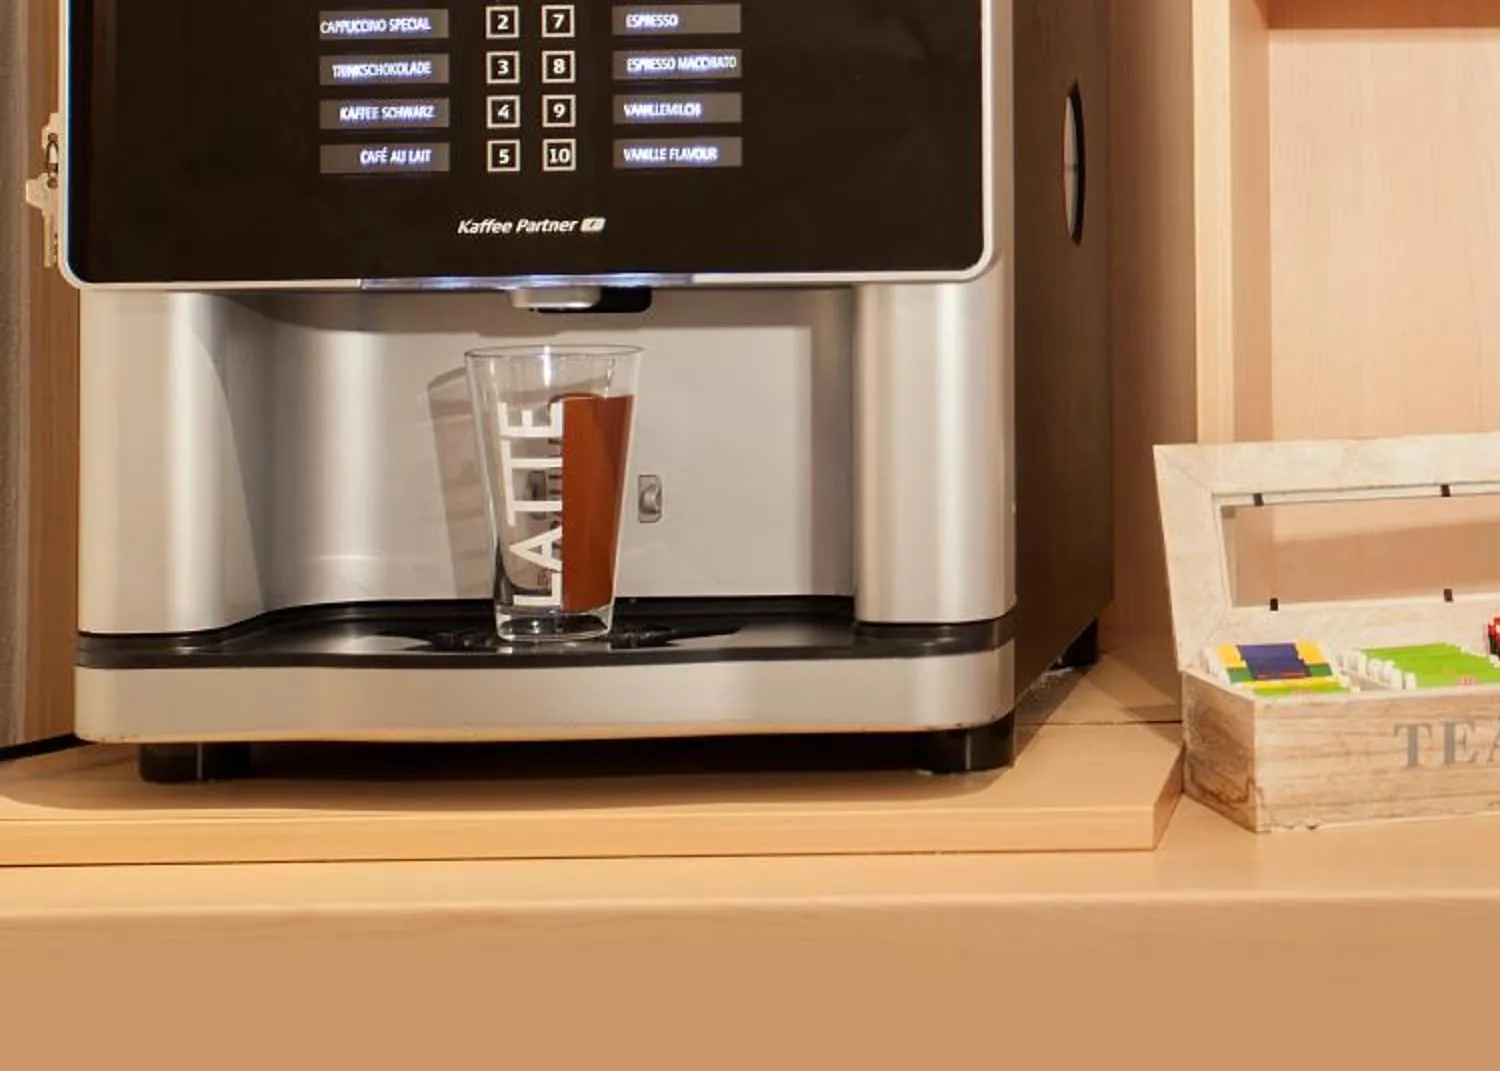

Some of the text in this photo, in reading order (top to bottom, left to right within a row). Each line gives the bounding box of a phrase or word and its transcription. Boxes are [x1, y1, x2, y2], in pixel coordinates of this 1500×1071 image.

[320, 17, 432, 34] CAPPUCCINO SPECIAL
[497, 14, 509, 30] 2
[552, 13, 565, 29] 7
[626, 14, 679, 28] ESPRESSO
[332, 61, 432, 78] TRINKSCHOKOLADE
[497, 59, 509, 75] 3
[552, 58, 565, 74] 8
[627, 55, 737, 72] ESPRESSO MACCHIATO
[340, 105, 436, 120] KAFFEE SCHWARZ
[498, 104, 510, 119] 4
[552, 102, 565, 118] 9
[360, 146, 432, 165] CAFÉ AU LAIT
[499, 148, 511, 164] 5
[550, 147, 571, 164] 10
[624, 147, 718, 162] VANILLE FLAVOUR
[457, 217, 579, 234] Kaffee Partner
[499, 402, 562, 606] LATTE
